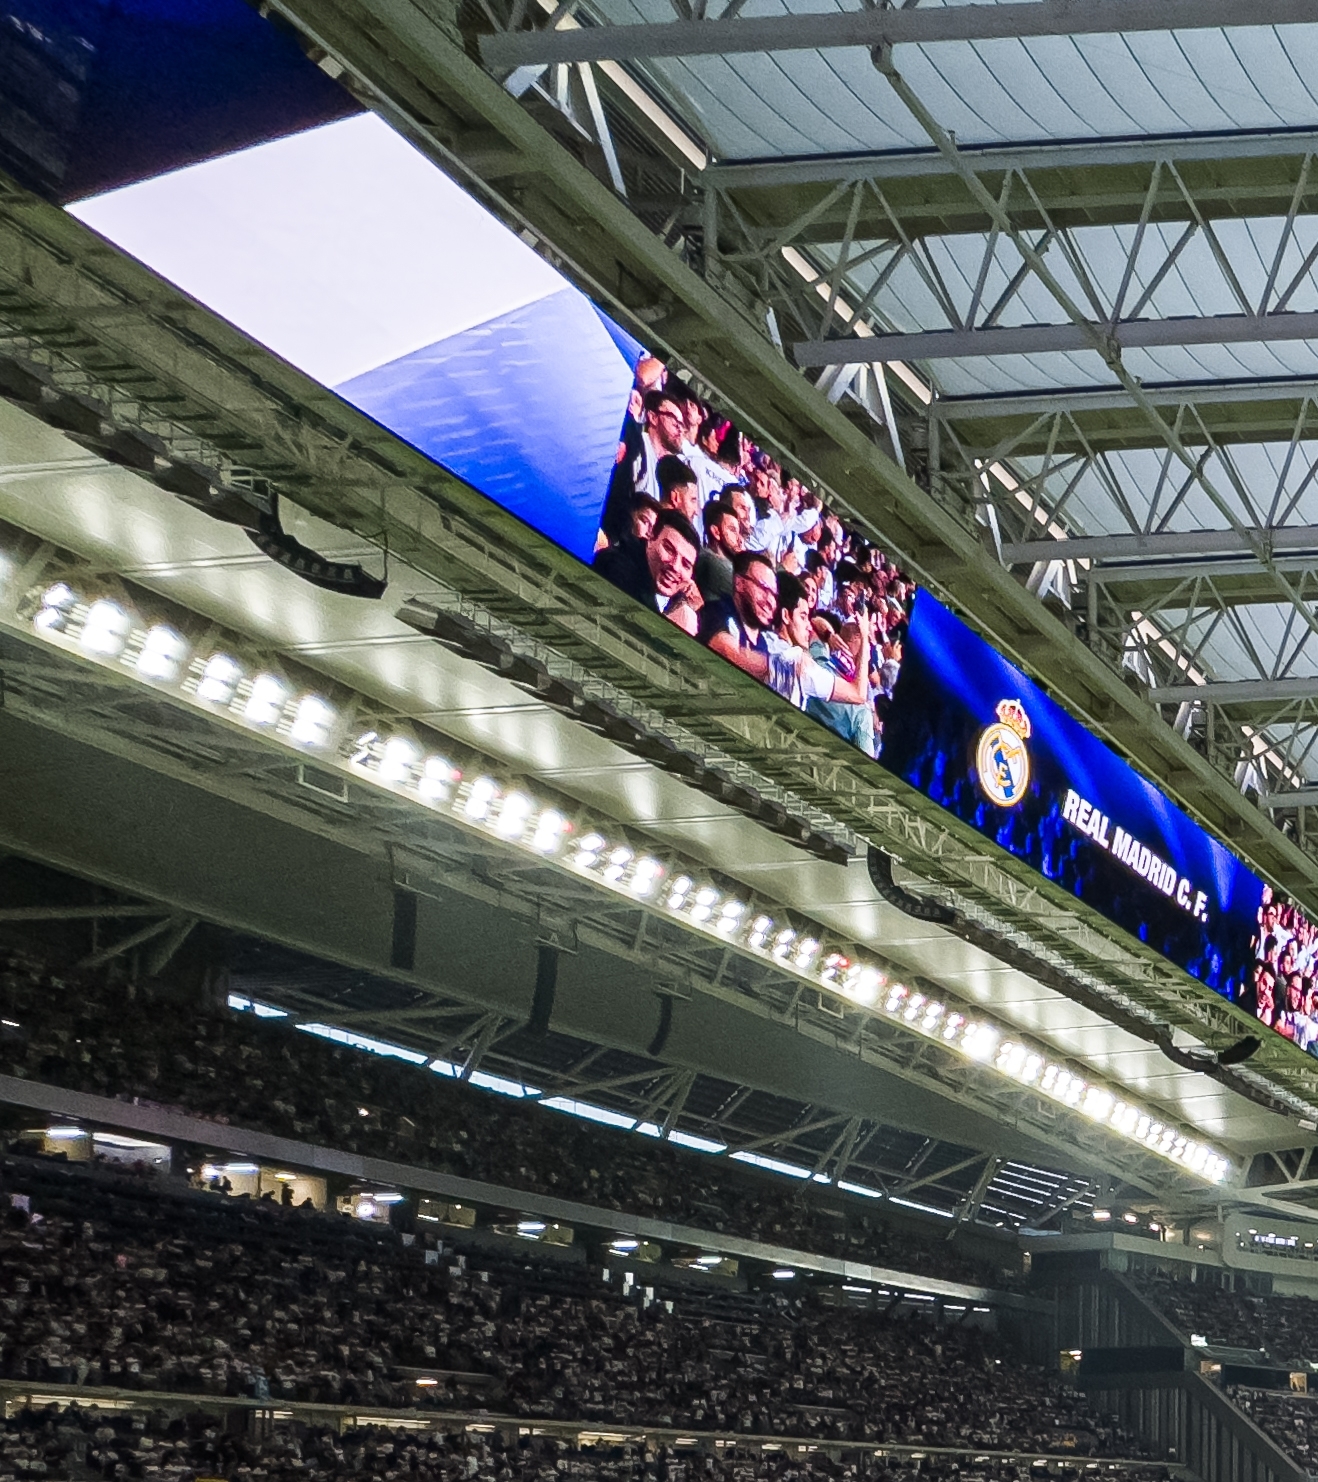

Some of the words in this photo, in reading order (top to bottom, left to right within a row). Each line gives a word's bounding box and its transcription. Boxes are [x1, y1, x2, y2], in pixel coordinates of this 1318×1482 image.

[1062, 788, 1109, 849] REAL
[1112, 826, 1177, 896] MADRID
[1177, 878, 1193, 910] C.
[1193, 890, 1208, 922] F.
